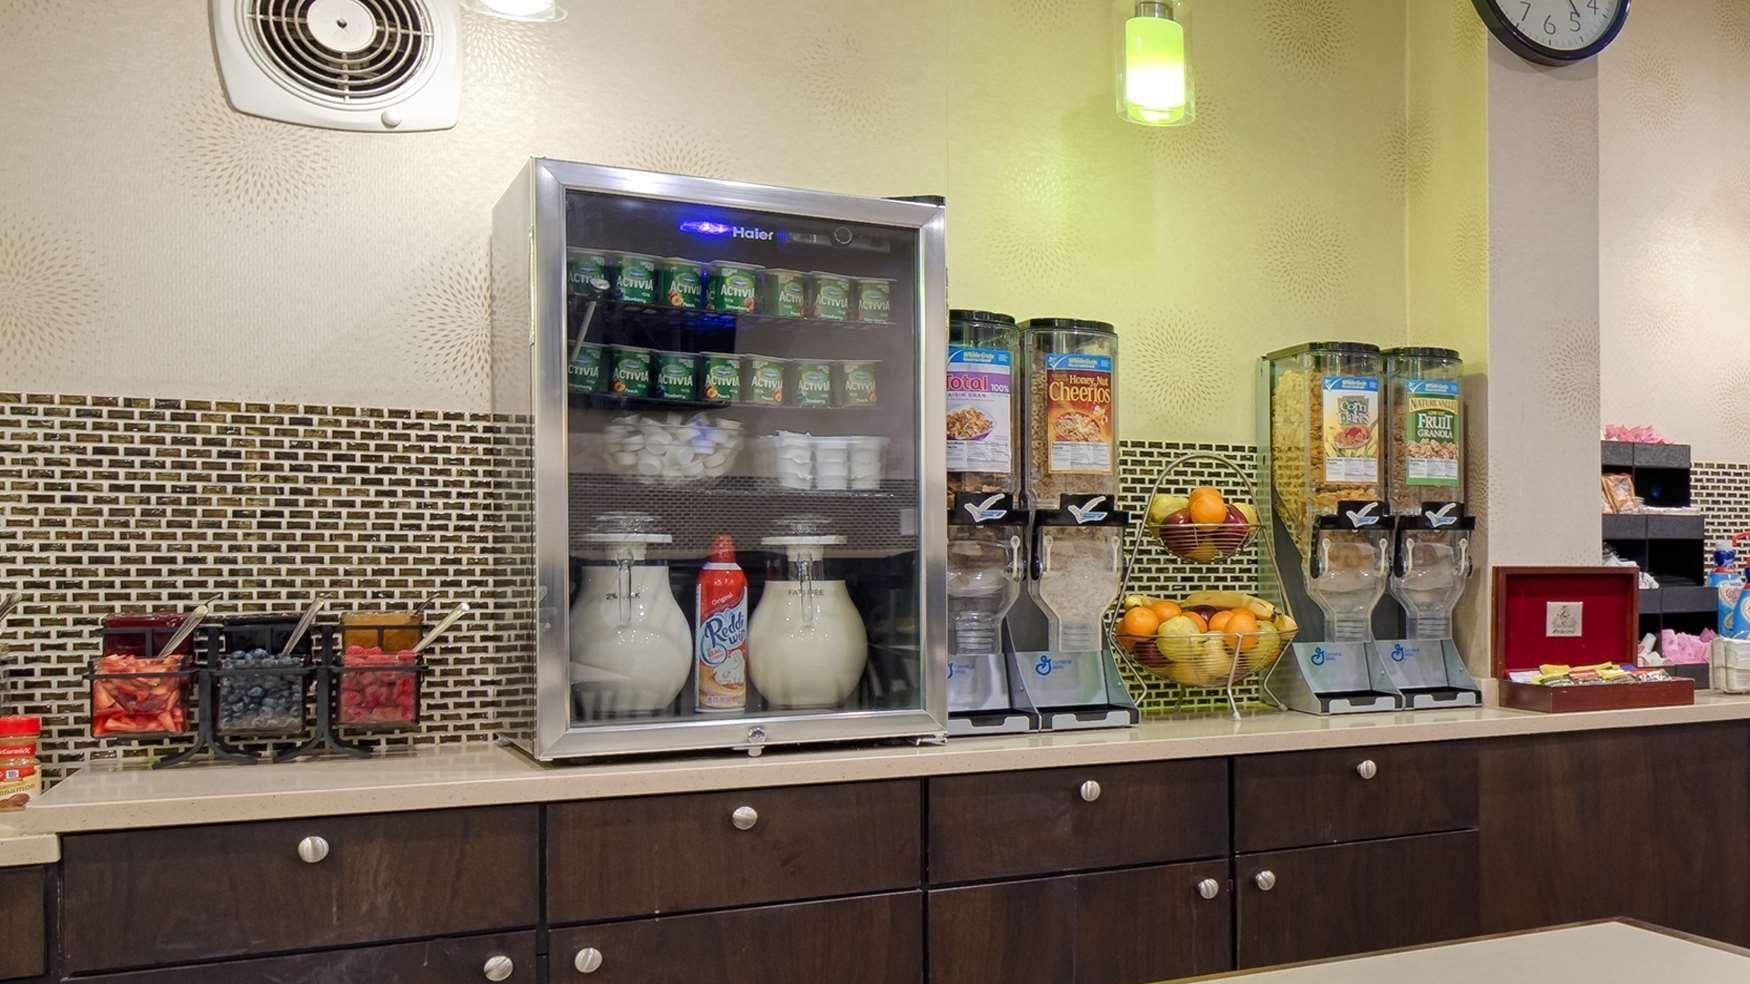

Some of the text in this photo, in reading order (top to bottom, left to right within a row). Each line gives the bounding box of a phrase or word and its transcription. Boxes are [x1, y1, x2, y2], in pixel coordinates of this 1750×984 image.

[1519, 1, 1532, 22] 7
[1543, 15, 1557, 36] 6
[1569, 12, 1582, 32] 5
[732, 226, 774, 240] Haier
[616, 275, 654, 291] ACTIVIA
[567, 364, 599, 377] CTIVIA
[612, 367, 649, 382] ACTIVIA
[657, 373, 694, 386] ACTIVIA
[704, 373, 740, 387] ACTIVIA
[1069, 374, 1095, 386] Honey
[1096, 376, 1109, 387] Nut
[990, 383, 1009, 392] 100%
[1049, 381, 1111, 403] Cheerios
[1418, 413, 1453, 430] FRUIT
[1416, 429, 1453, 439] GRANOLA
[705, 612, 744, 647] Reddi
